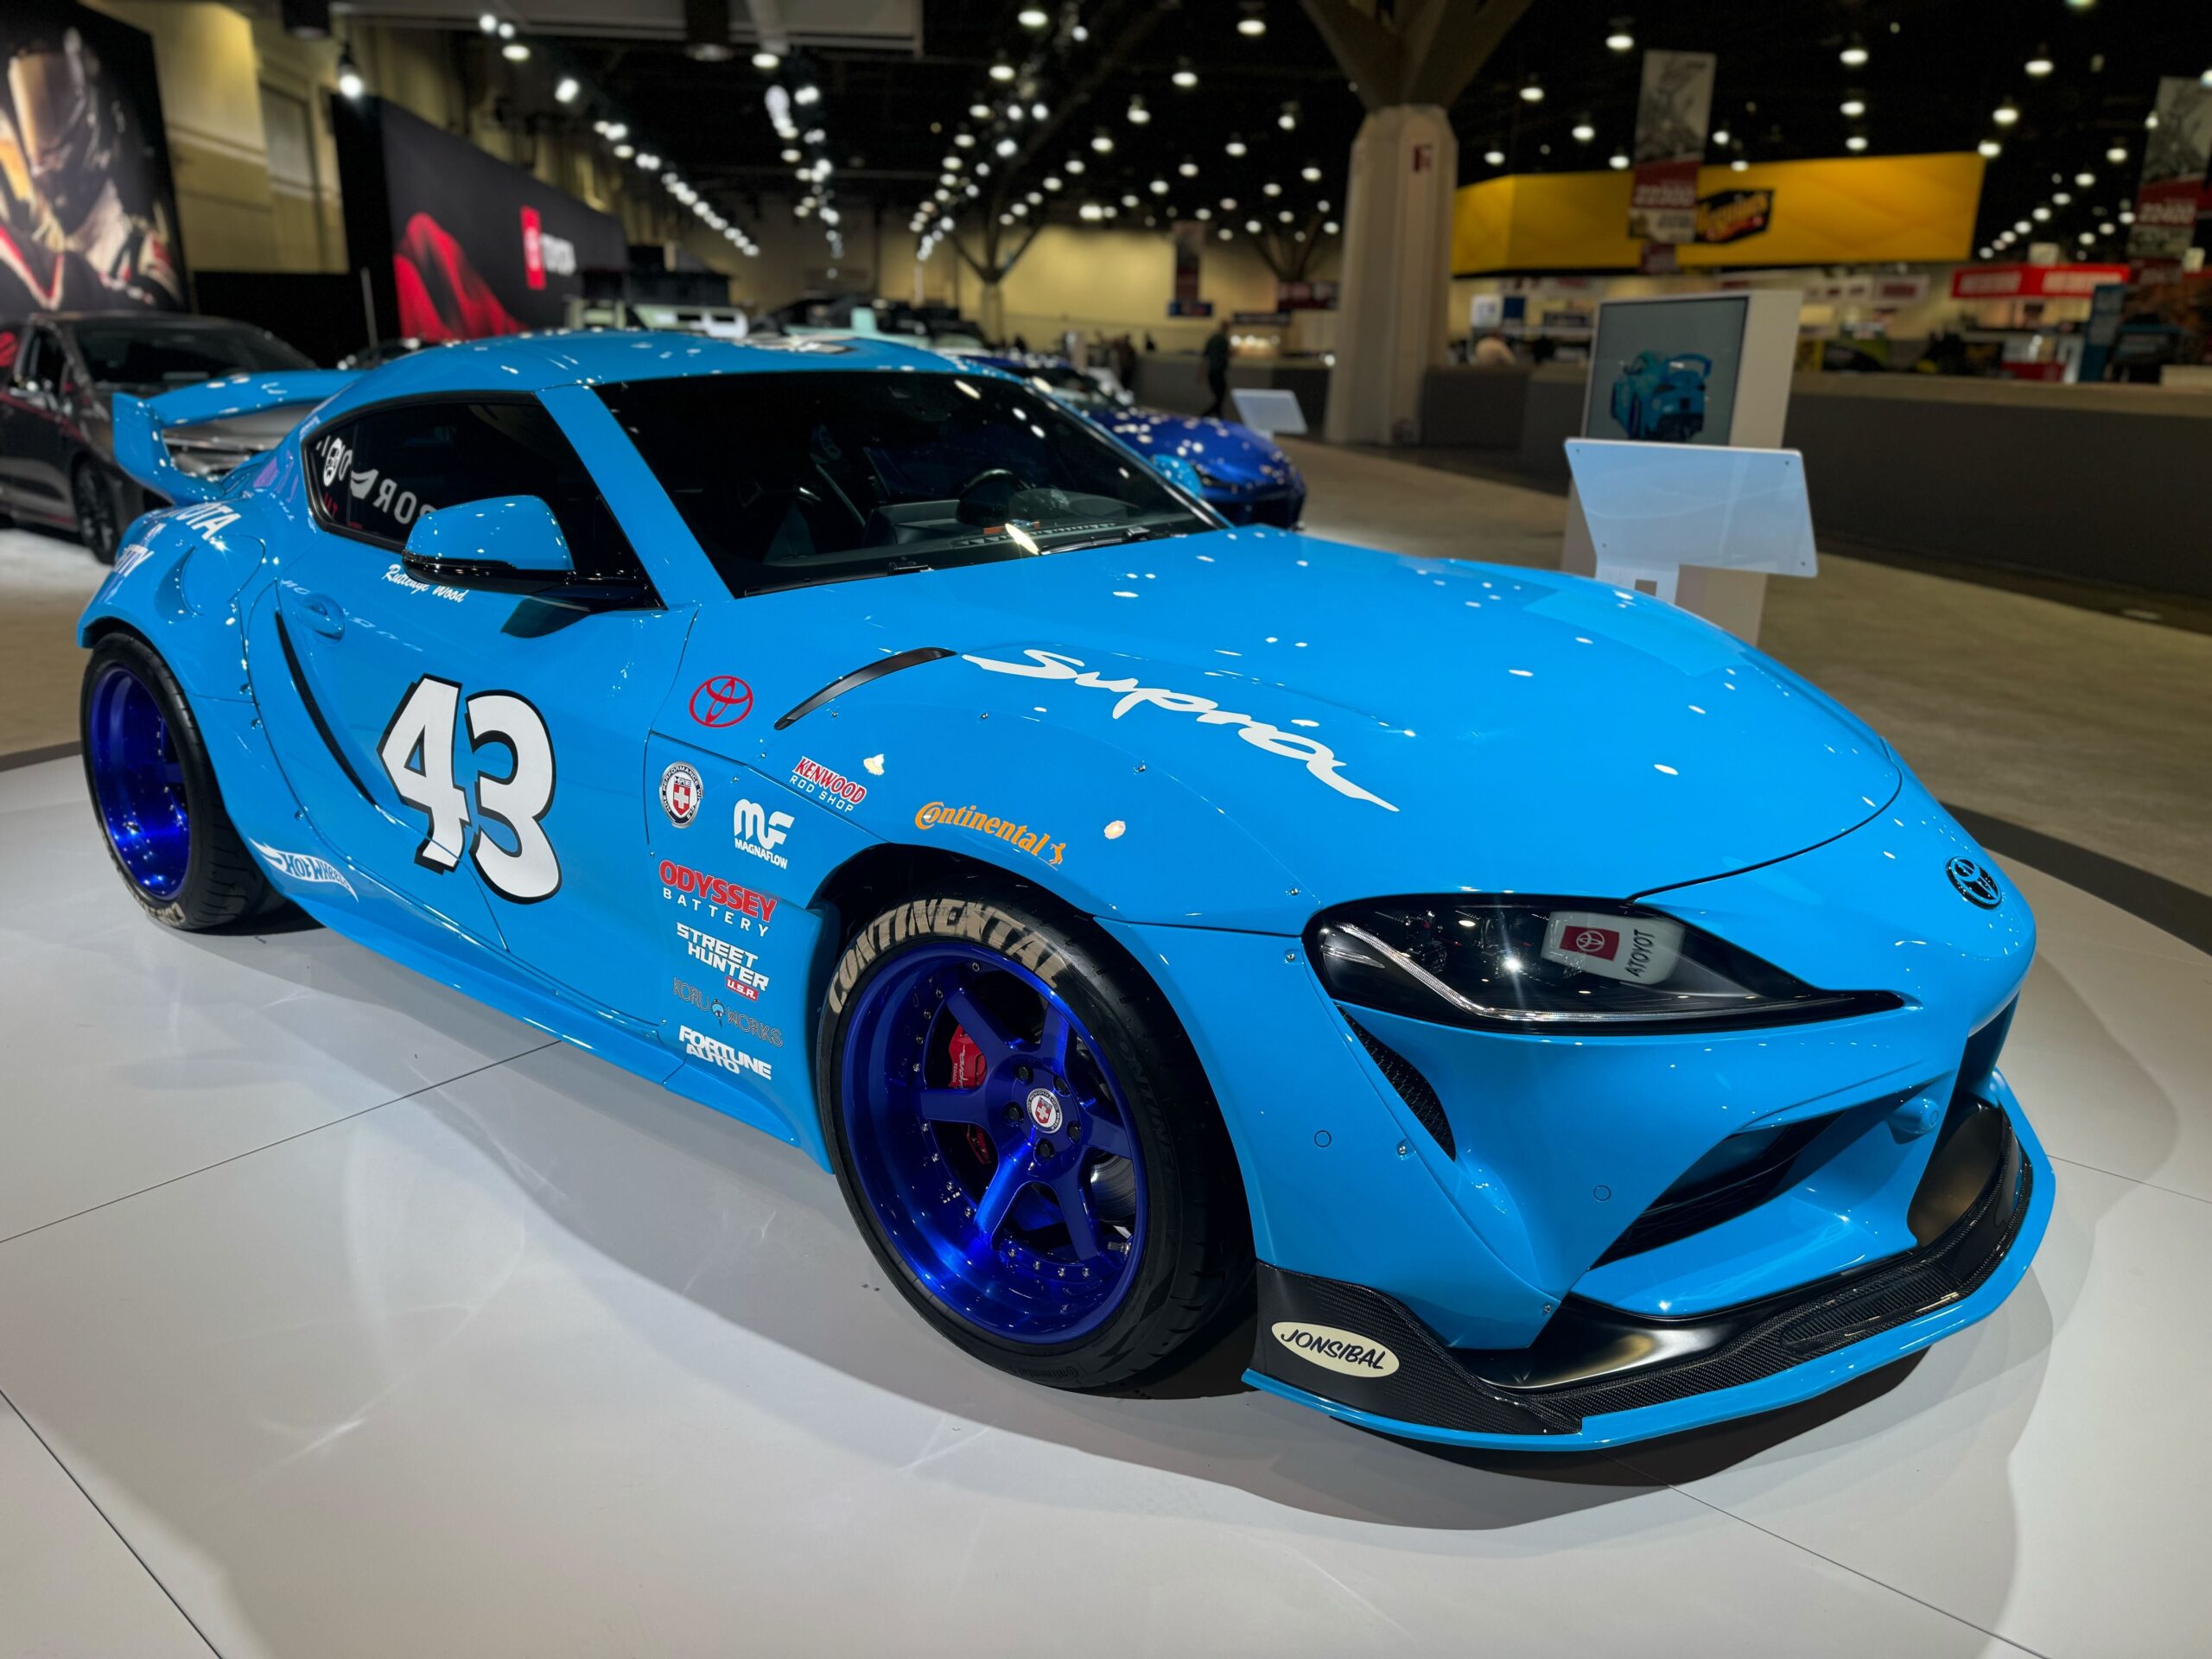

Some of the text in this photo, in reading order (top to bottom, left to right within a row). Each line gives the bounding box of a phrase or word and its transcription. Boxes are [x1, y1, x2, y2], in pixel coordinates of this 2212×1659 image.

[432, 585, 469, 603] Wood
[961, 649, 1400, 813] Supra
[375, 672, 563, 905] 43
[674, 776, 691, 787] HRE
[789, 774, 854, 812] ROD SHOP
[791, 756, 868, 804] KENWOOD
[914, 801, 1051, 856] Continental
[734, 837, 788, 870] MAGNAFLOW
[659, 860, 777, 923] ODYSSEY
[663, 887, 770, 938] BATTERY
[677, 922, 759, 969] STREET
[688, 941, 770, 991] HUNTER
[673, 977, 784, 1048] KORU WORKS
[678, 1025, 772, 1080] FORTUNE
[686, 1043, 740, 1074] AUTO
[1280, 1329, 1384, 1370] JONSIBAL
